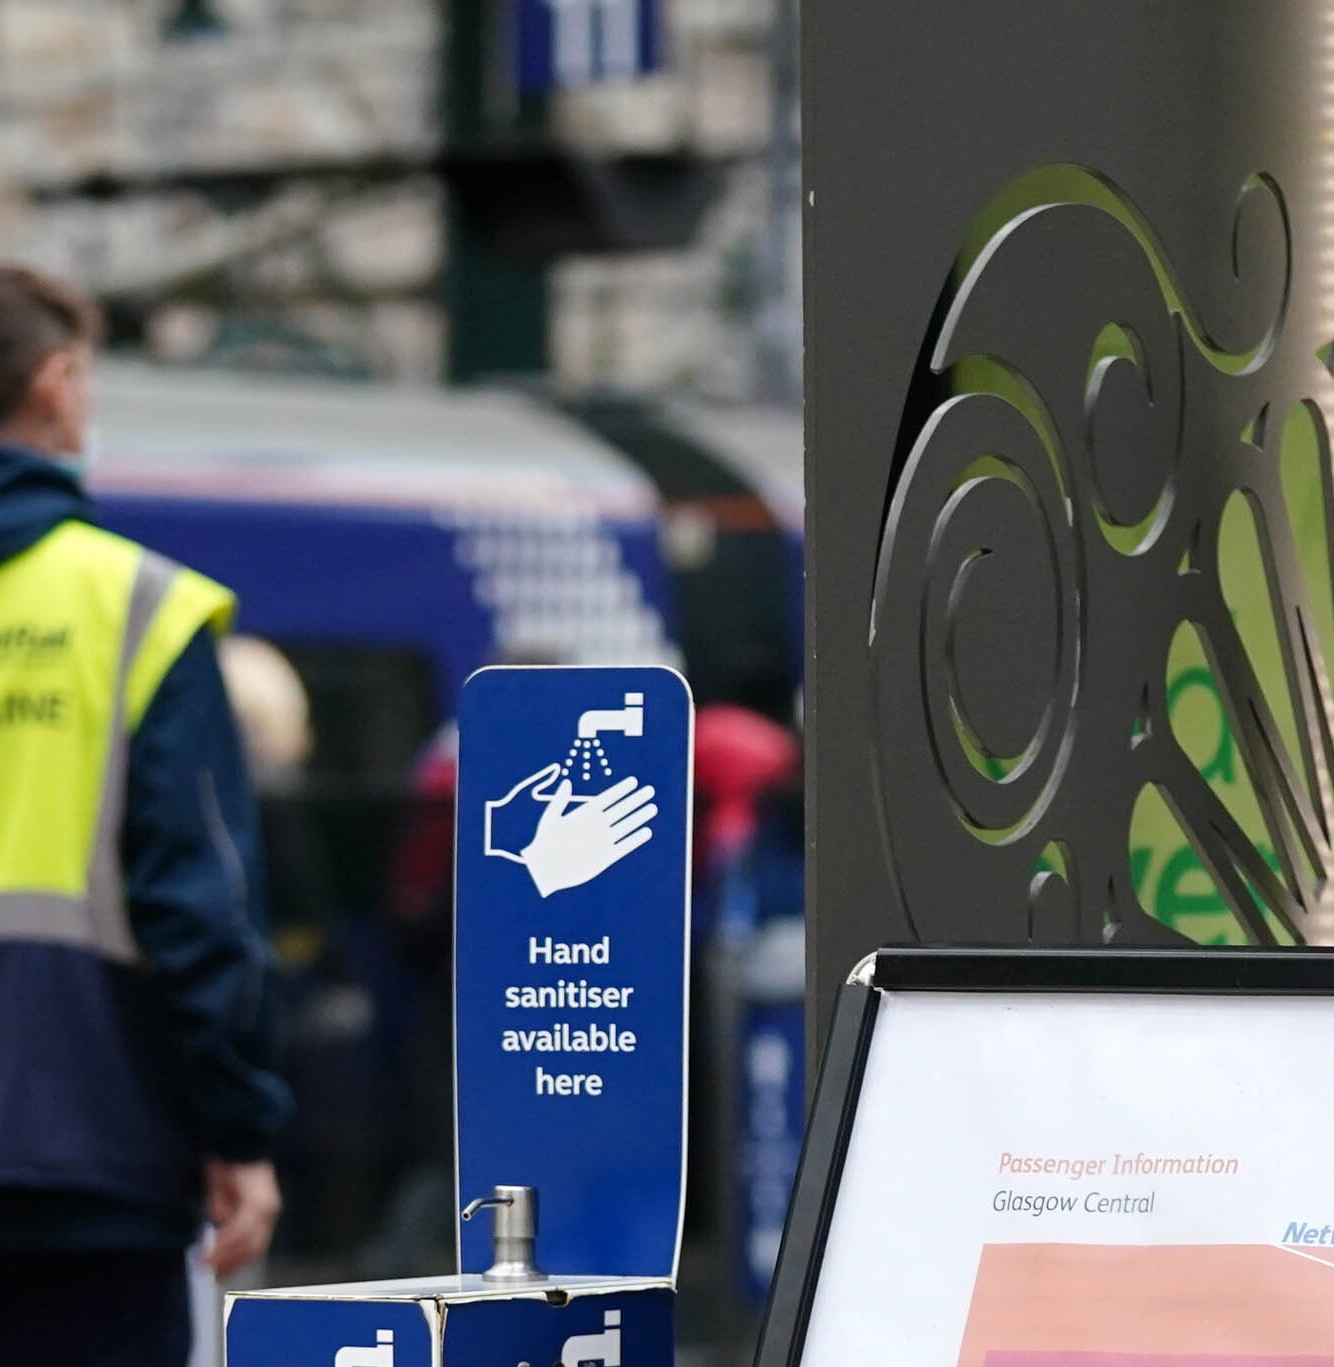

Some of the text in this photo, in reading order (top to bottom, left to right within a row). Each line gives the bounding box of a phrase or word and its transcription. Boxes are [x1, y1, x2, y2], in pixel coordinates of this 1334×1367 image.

[529, 934, 609, 965] Hand
[505, 979, 633, 1009] sanitiser
[502, 1022, 636, 1052] available
[536, 1065, 602, 1096] here
[998, 1153, 1238, 1180] Passenger Information
[993, 1191, 1155, 1216] Glasgow Central
